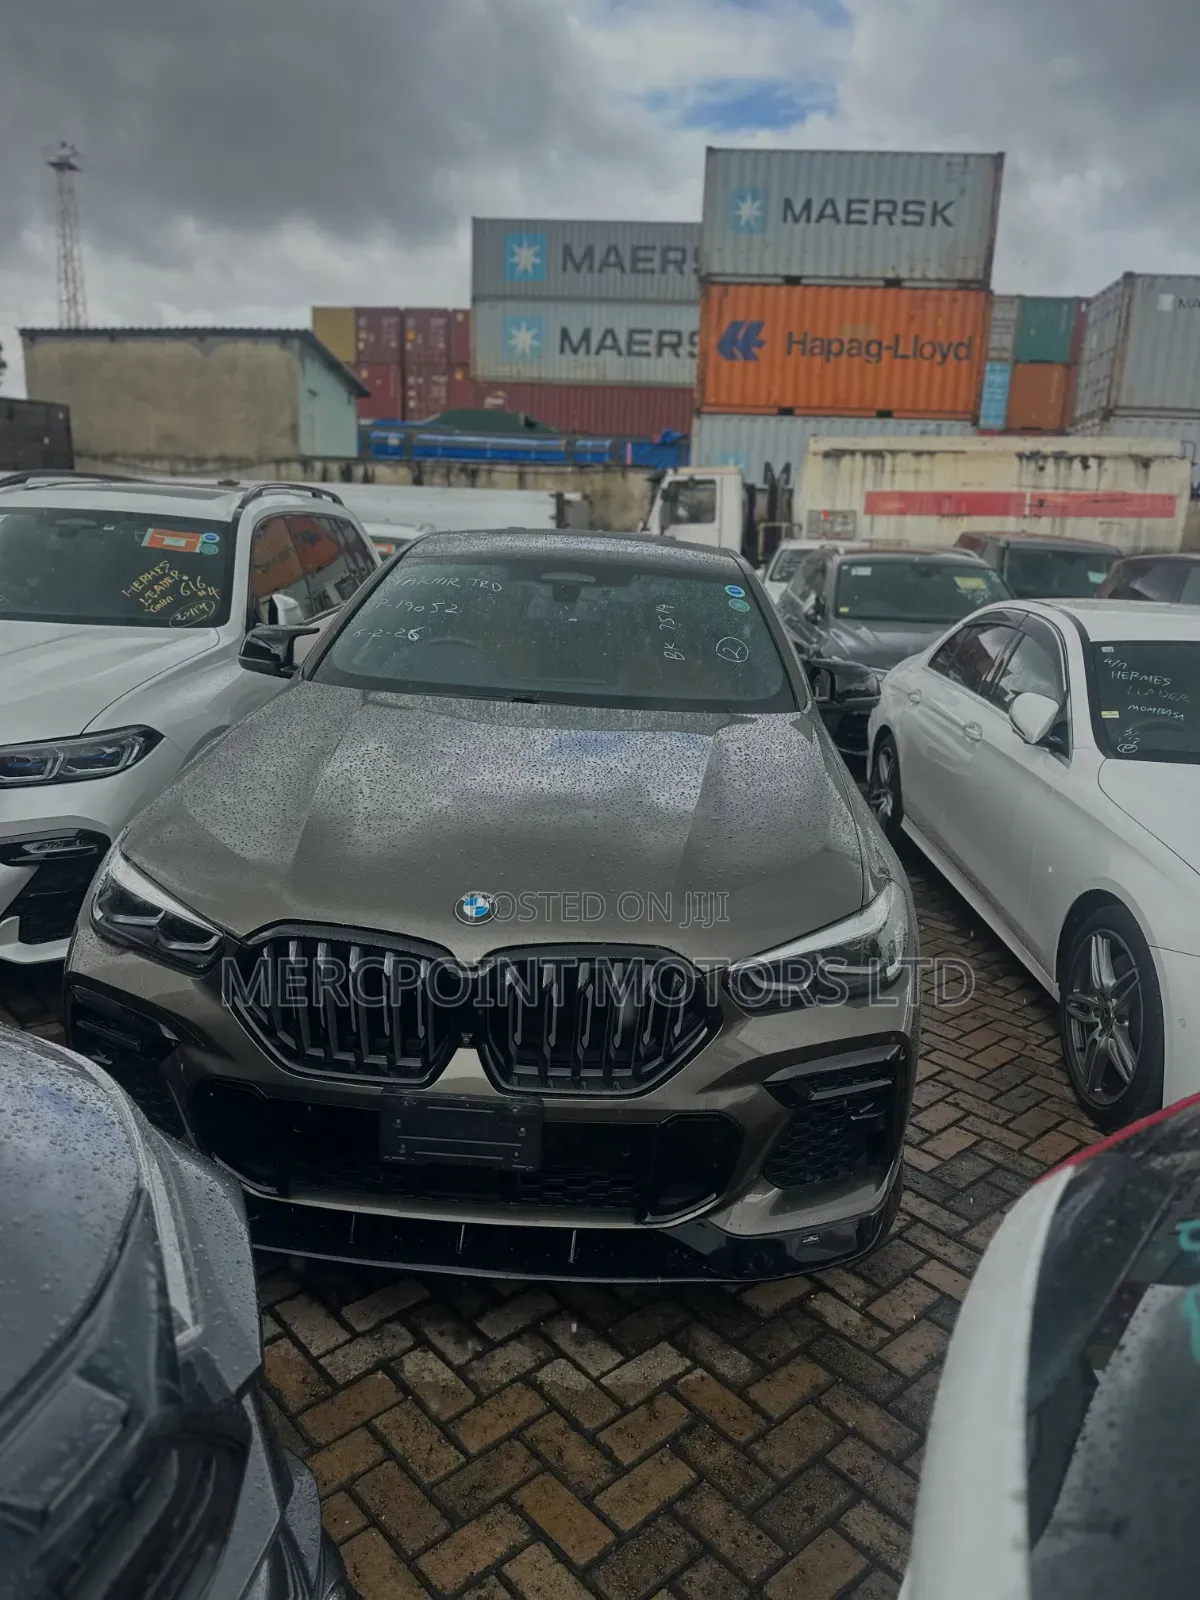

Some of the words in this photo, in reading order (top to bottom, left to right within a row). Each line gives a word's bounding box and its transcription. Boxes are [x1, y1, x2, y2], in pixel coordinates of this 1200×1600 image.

[782, 197, 956, 228] MAERSK
[561, 243, 700, 276] MAER
[786, 331, 972, 366] Hapag-Lloyd
[1111, 671, 1172, 686] HERMES
[1128, 704, 1184, 721] MOMBASA
